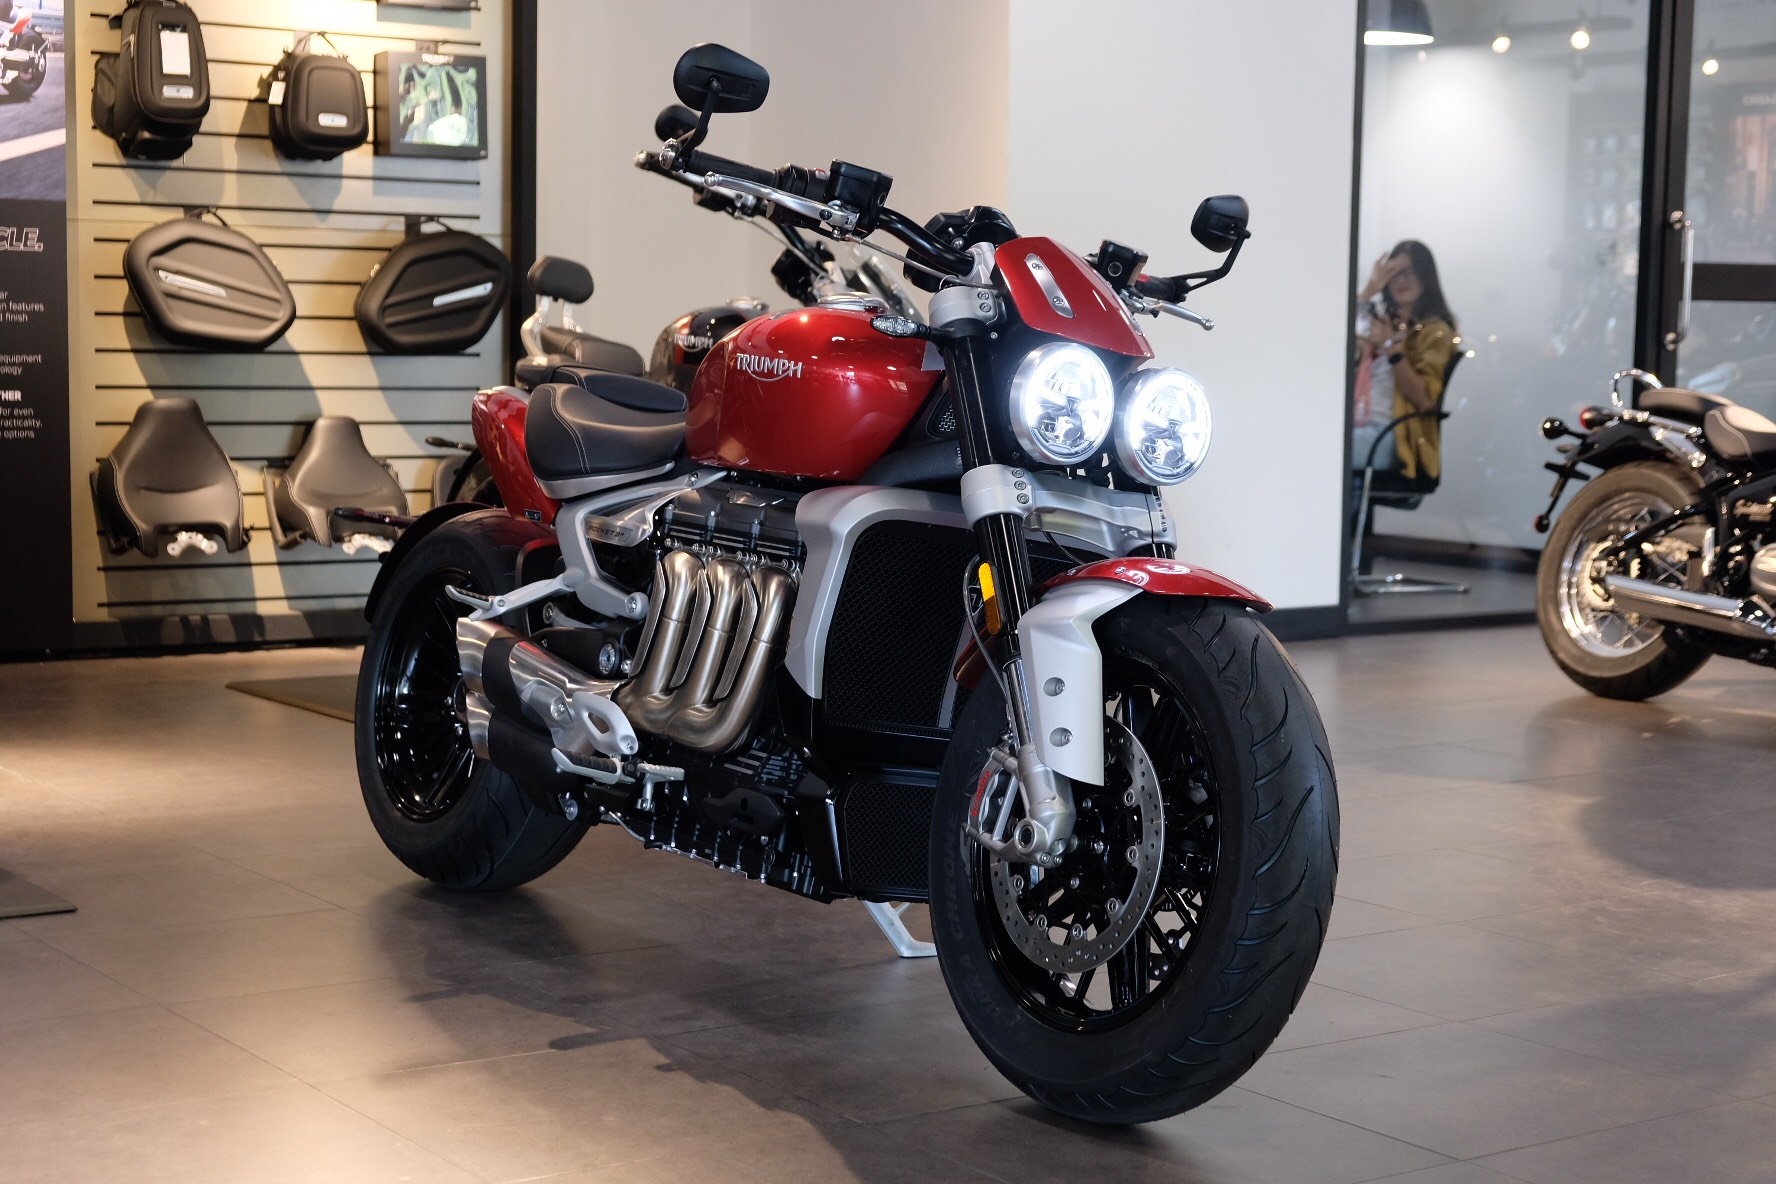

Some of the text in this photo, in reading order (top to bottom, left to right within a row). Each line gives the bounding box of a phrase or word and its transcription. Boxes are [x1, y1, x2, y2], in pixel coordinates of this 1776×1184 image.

[9, 300, 45, 312] features
[6, 312, 28, 322] finish
[736, 352, 804, 382] TRIUMPH
[13, 407, 34, 417] even
[3, 429, 35, 440] options
[588, 525, 615, 536] ROCKET
